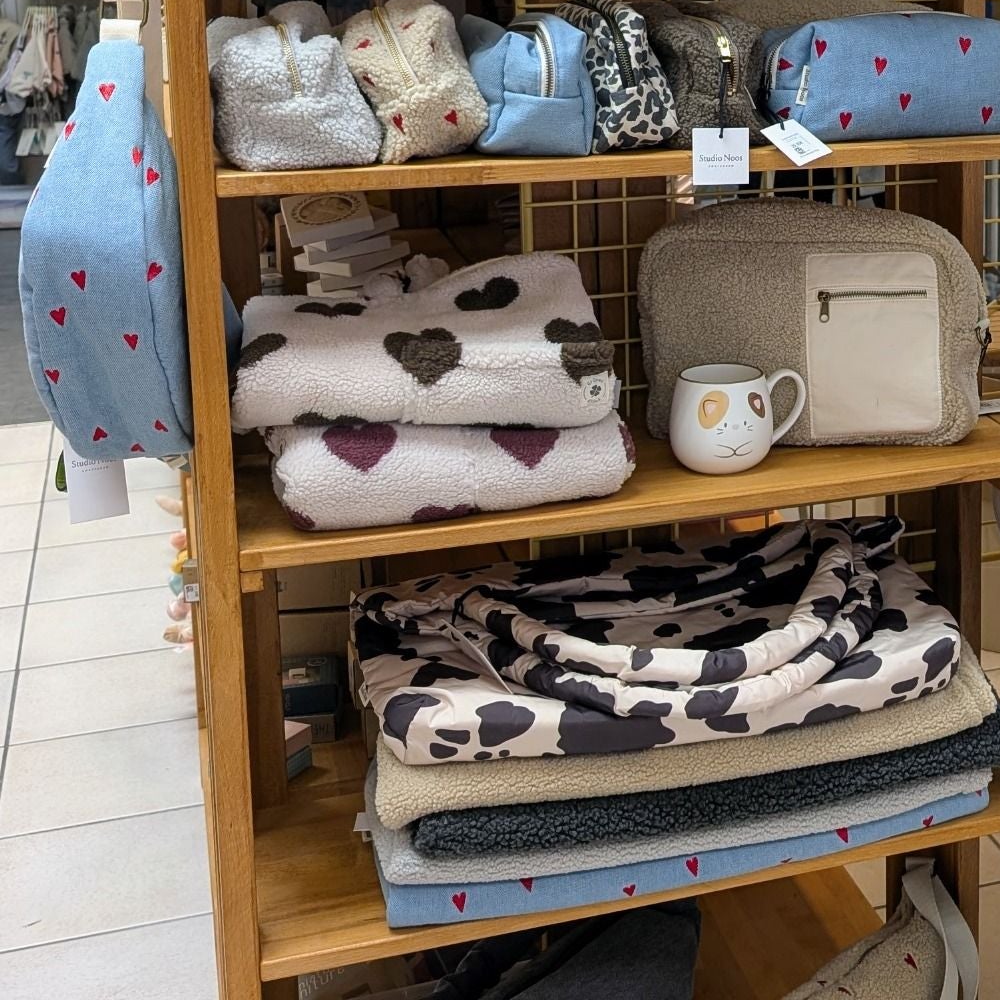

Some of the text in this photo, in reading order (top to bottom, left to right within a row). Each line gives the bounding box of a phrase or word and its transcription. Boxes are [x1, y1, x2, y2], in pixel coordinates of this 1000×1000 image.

[699, 153, 743, 162] Studio Noos
[71, 459, 96, 469] Studio
